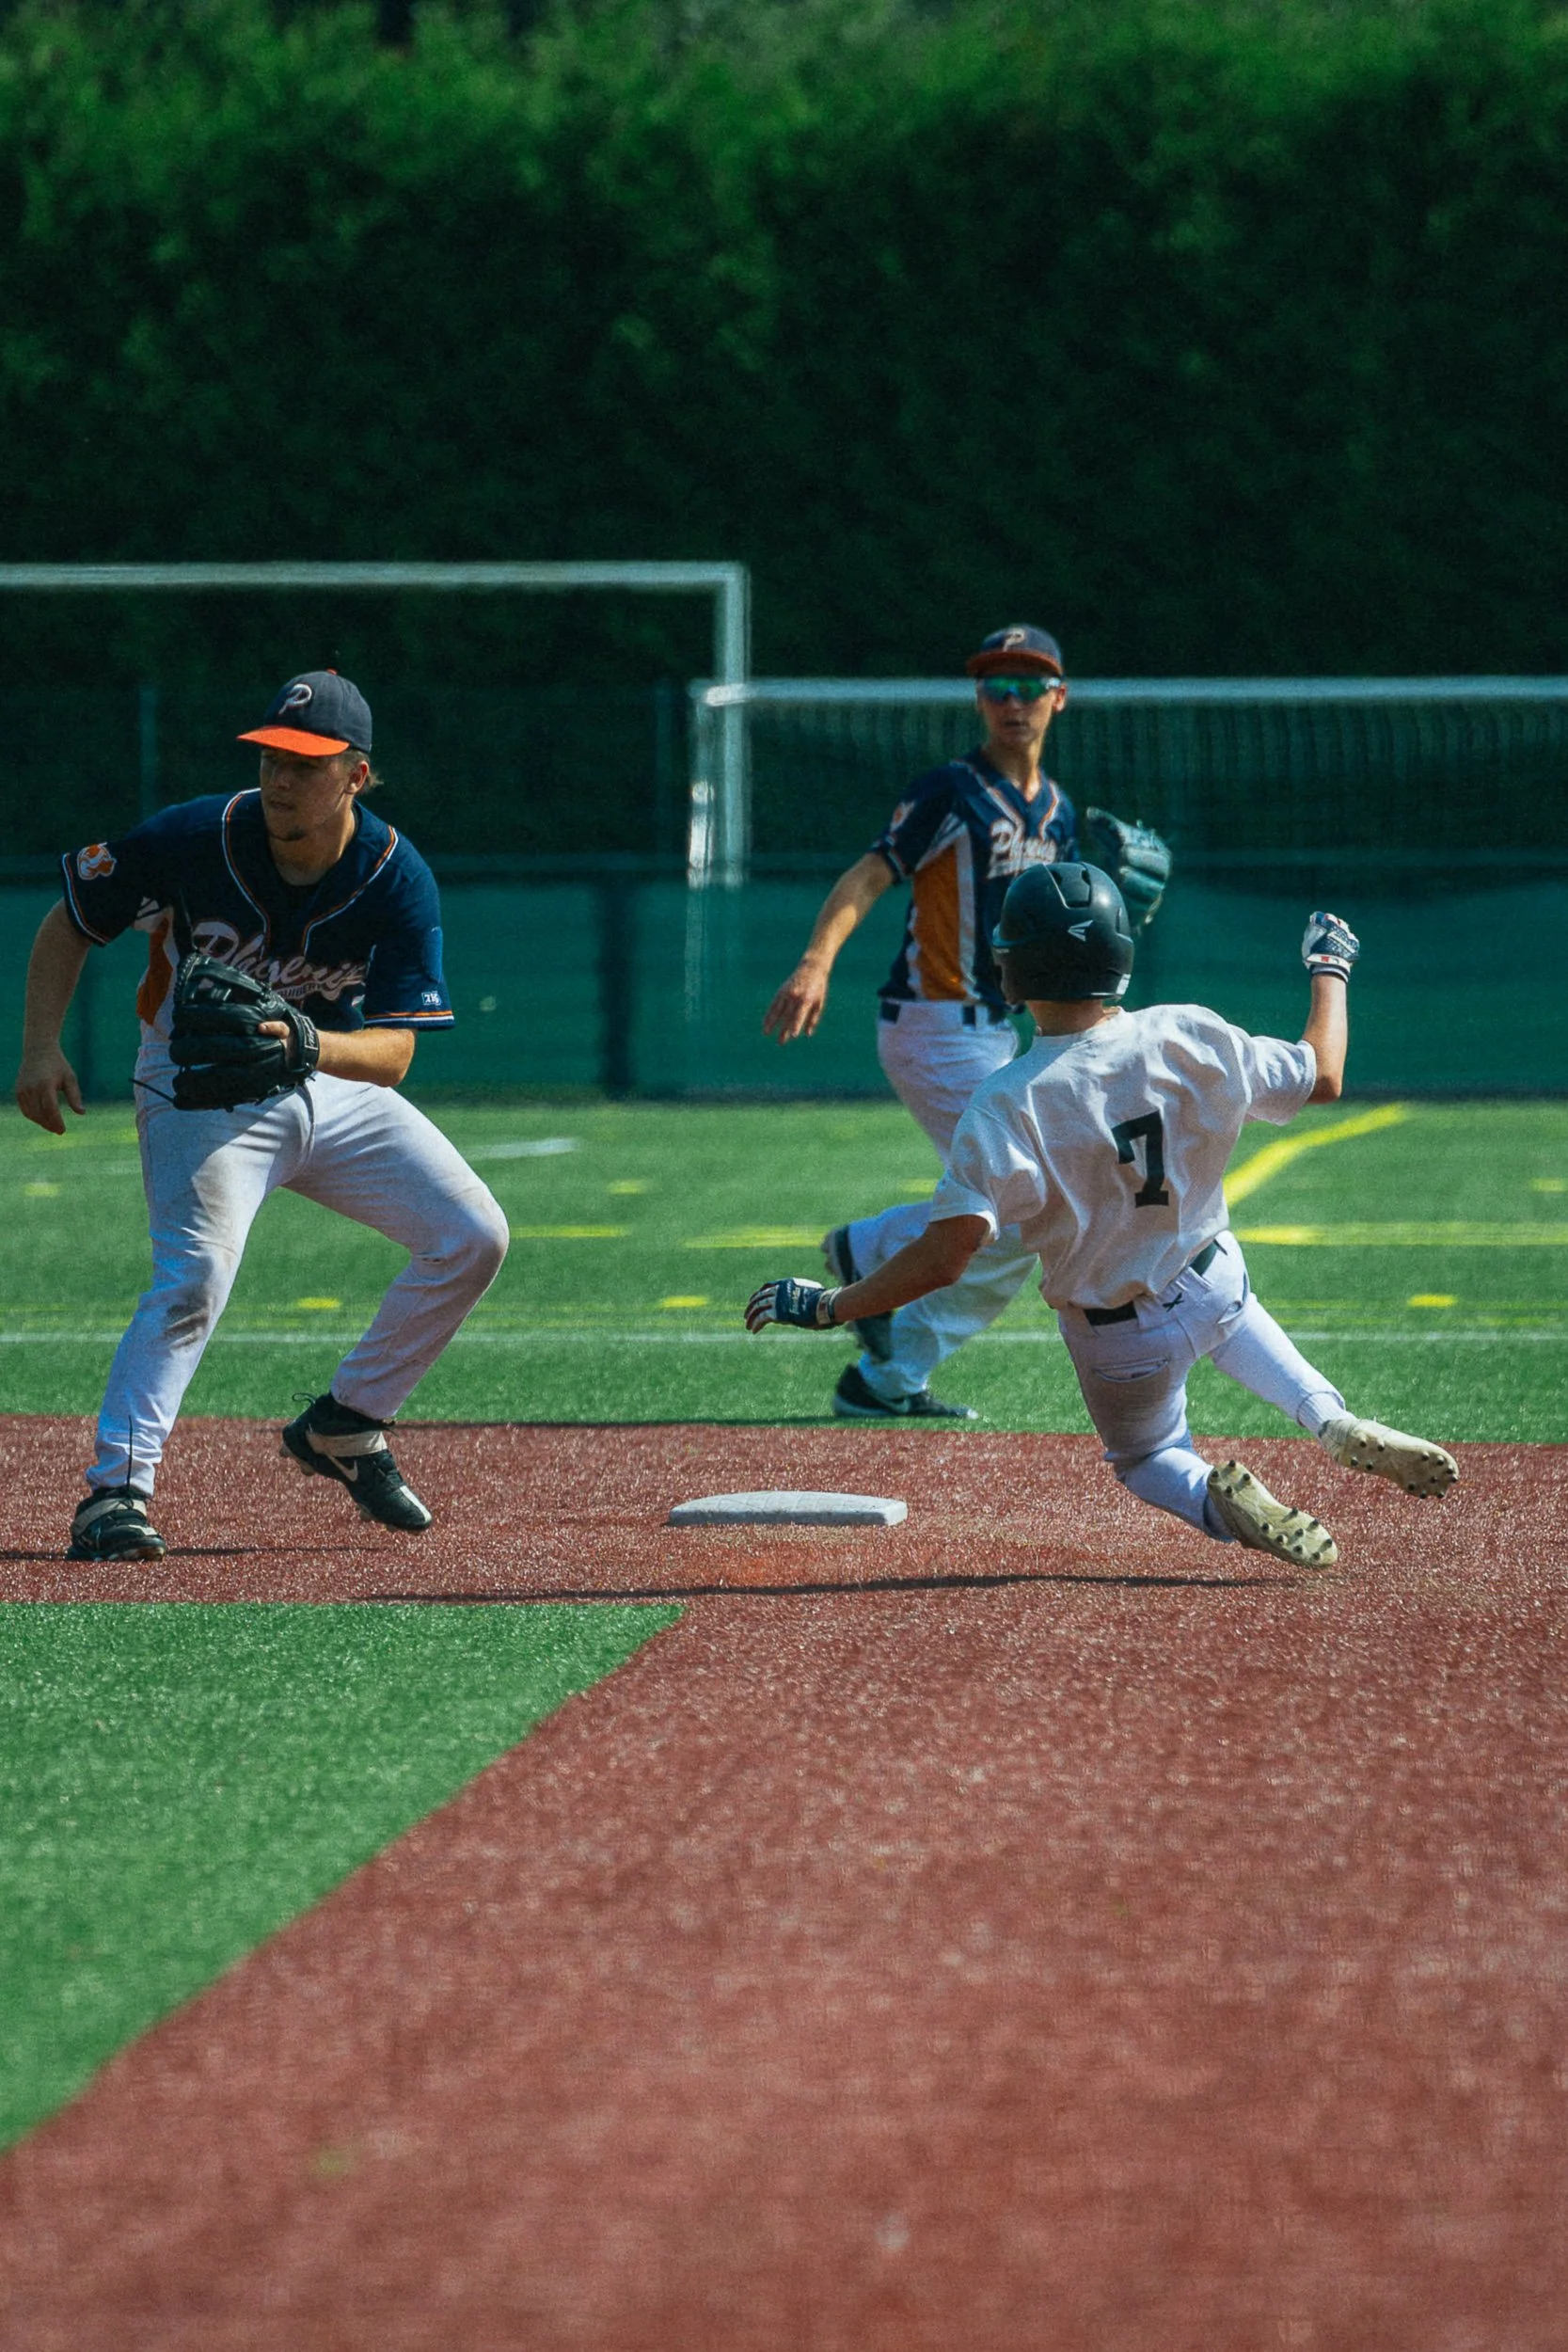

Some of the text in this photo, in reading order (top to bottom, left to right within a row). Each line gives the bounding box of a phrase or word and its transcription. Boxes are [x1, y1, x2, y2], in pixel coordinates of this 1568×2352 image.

[1003, 628, 1025, 652] P
[278, 683, 312, 715] P
[1111, 1110, 1169, 1208] 7
